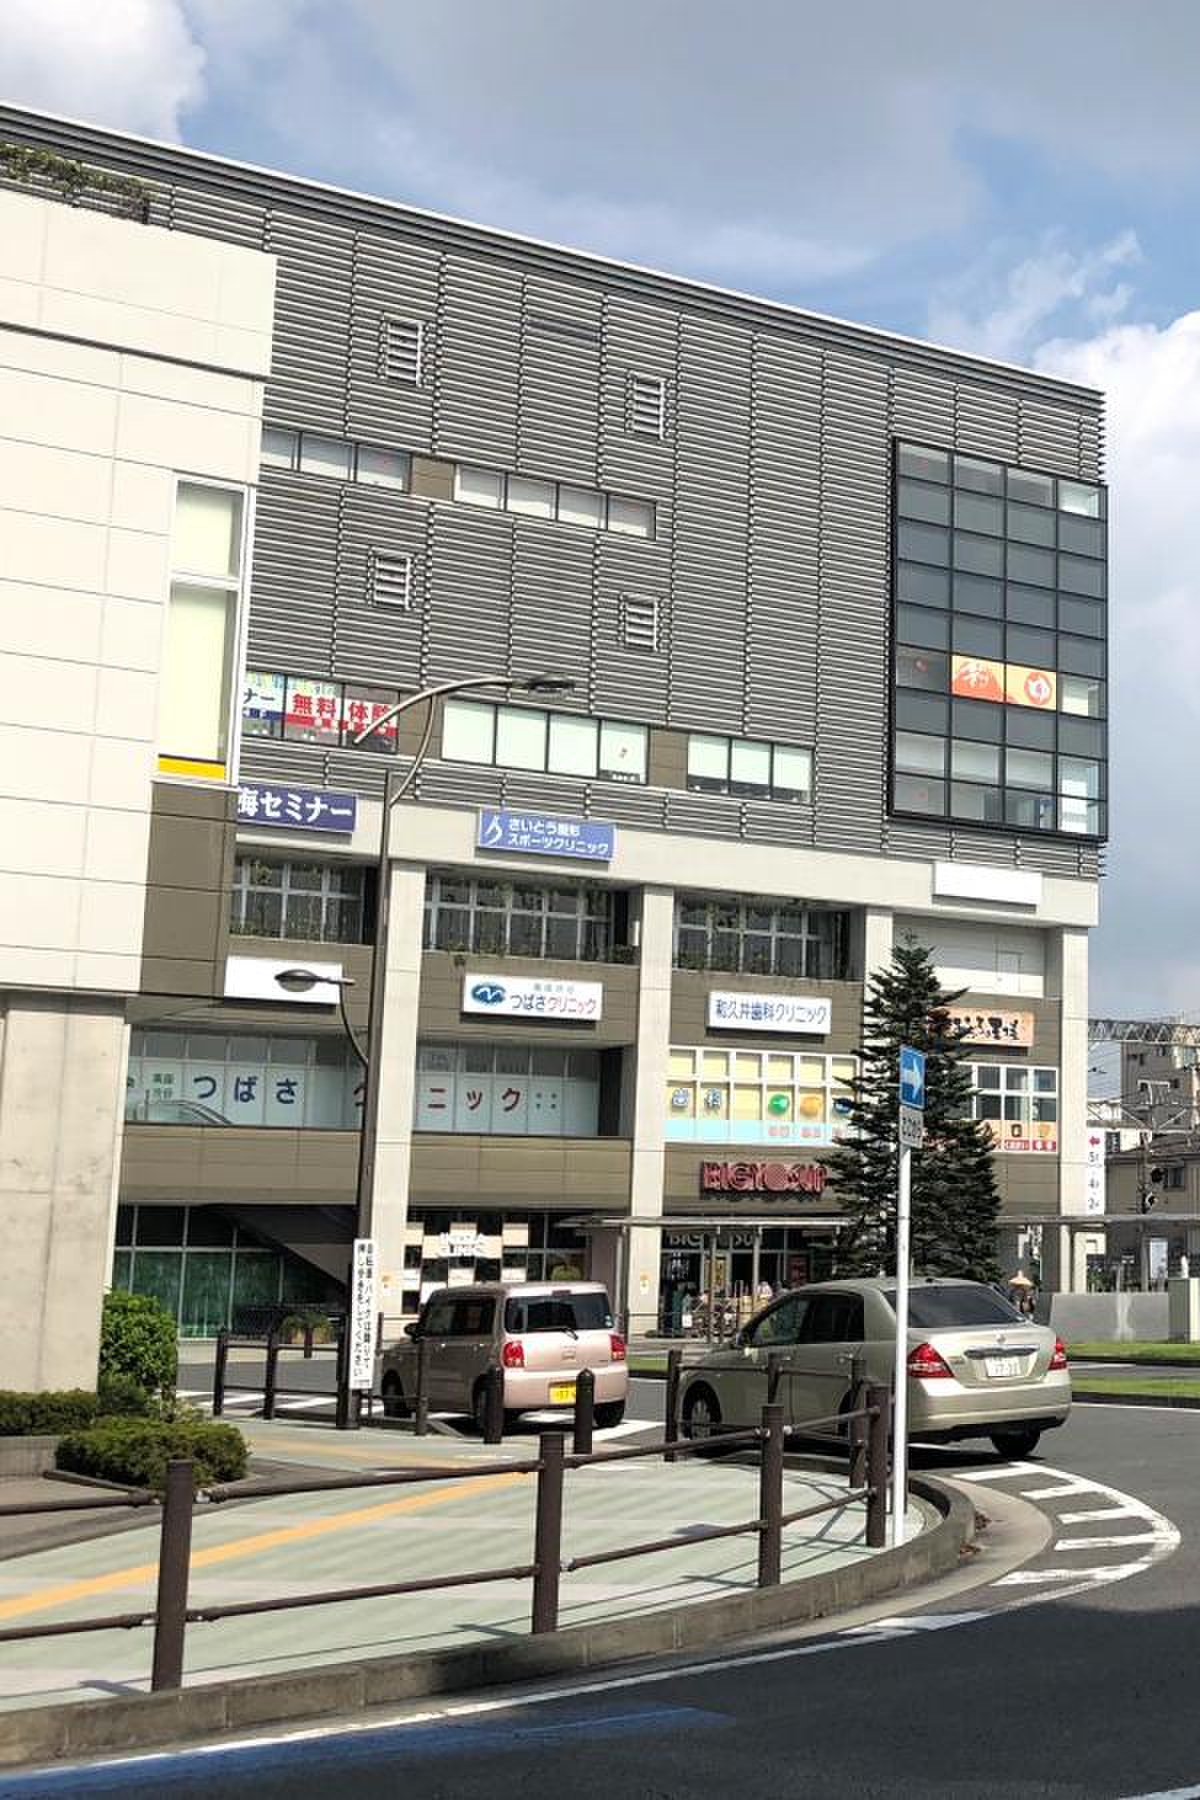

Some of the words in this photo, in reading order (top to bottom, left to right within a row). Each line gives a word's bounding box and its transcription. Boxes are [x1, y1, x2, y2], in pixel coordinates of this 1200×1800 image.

[237, 786, 353, 822] 海セミナー
[508, 832, 609, 856] スポーツクリニック
[509, 992, 598, 1015] つばさクリニック
[715, 998, 828, 1025] 和久井歯科クリニック
[193, 1076, 299, 1105] つばさ
